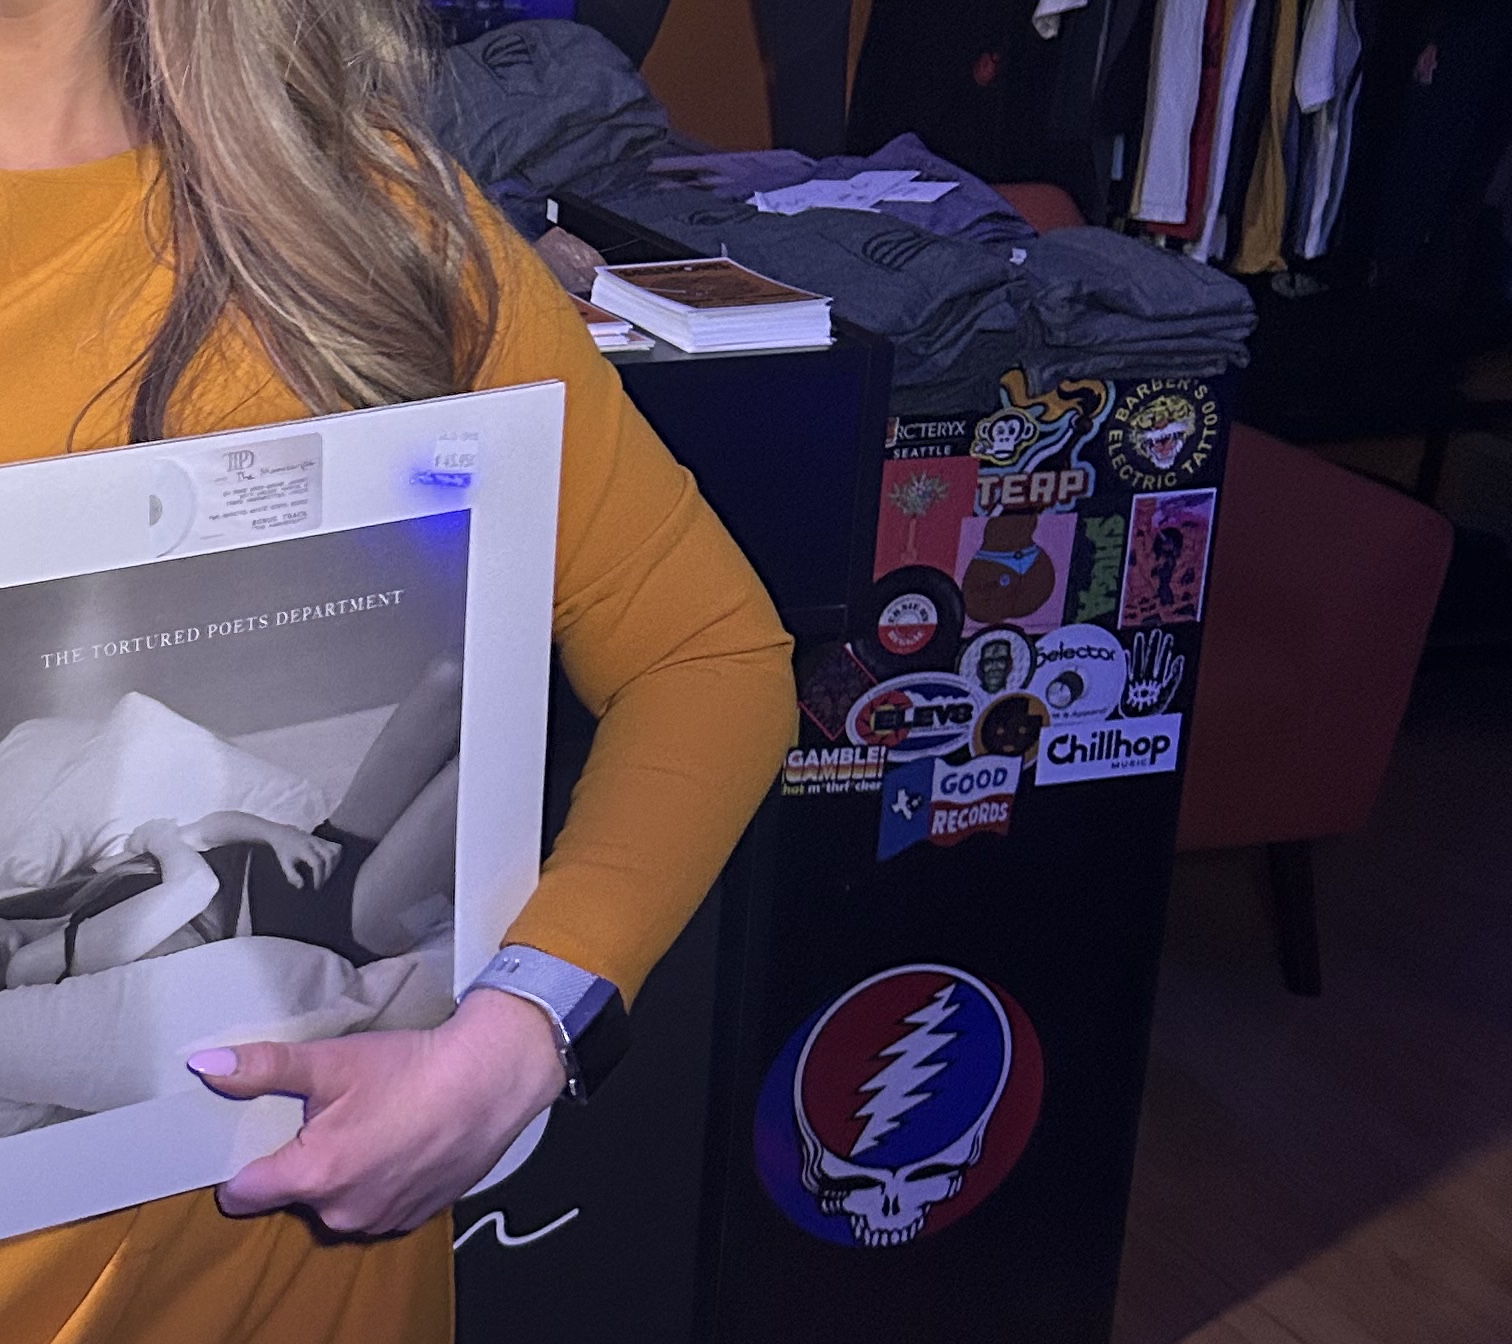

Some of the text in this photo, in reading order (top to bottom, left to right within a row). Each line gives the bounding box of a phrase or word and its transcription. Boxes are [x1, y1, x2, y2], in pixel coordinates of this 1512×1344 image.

[893, 444, 952, 460] SEATTLE
[1108, 400, 1218, 490] ELECTRIC TATTOO
[977, 469, 1085, 506] TERP
[41, 589, 405, 669] THE TORTURED POETS DEPARTMENT
[1047, 729, 1170, 765] Chillhop
[1111, 758, 1148, 769] MUSIC
[941, 768, 1008, 795] GOOD
[931, 801, 1009, 836] RECORDS
